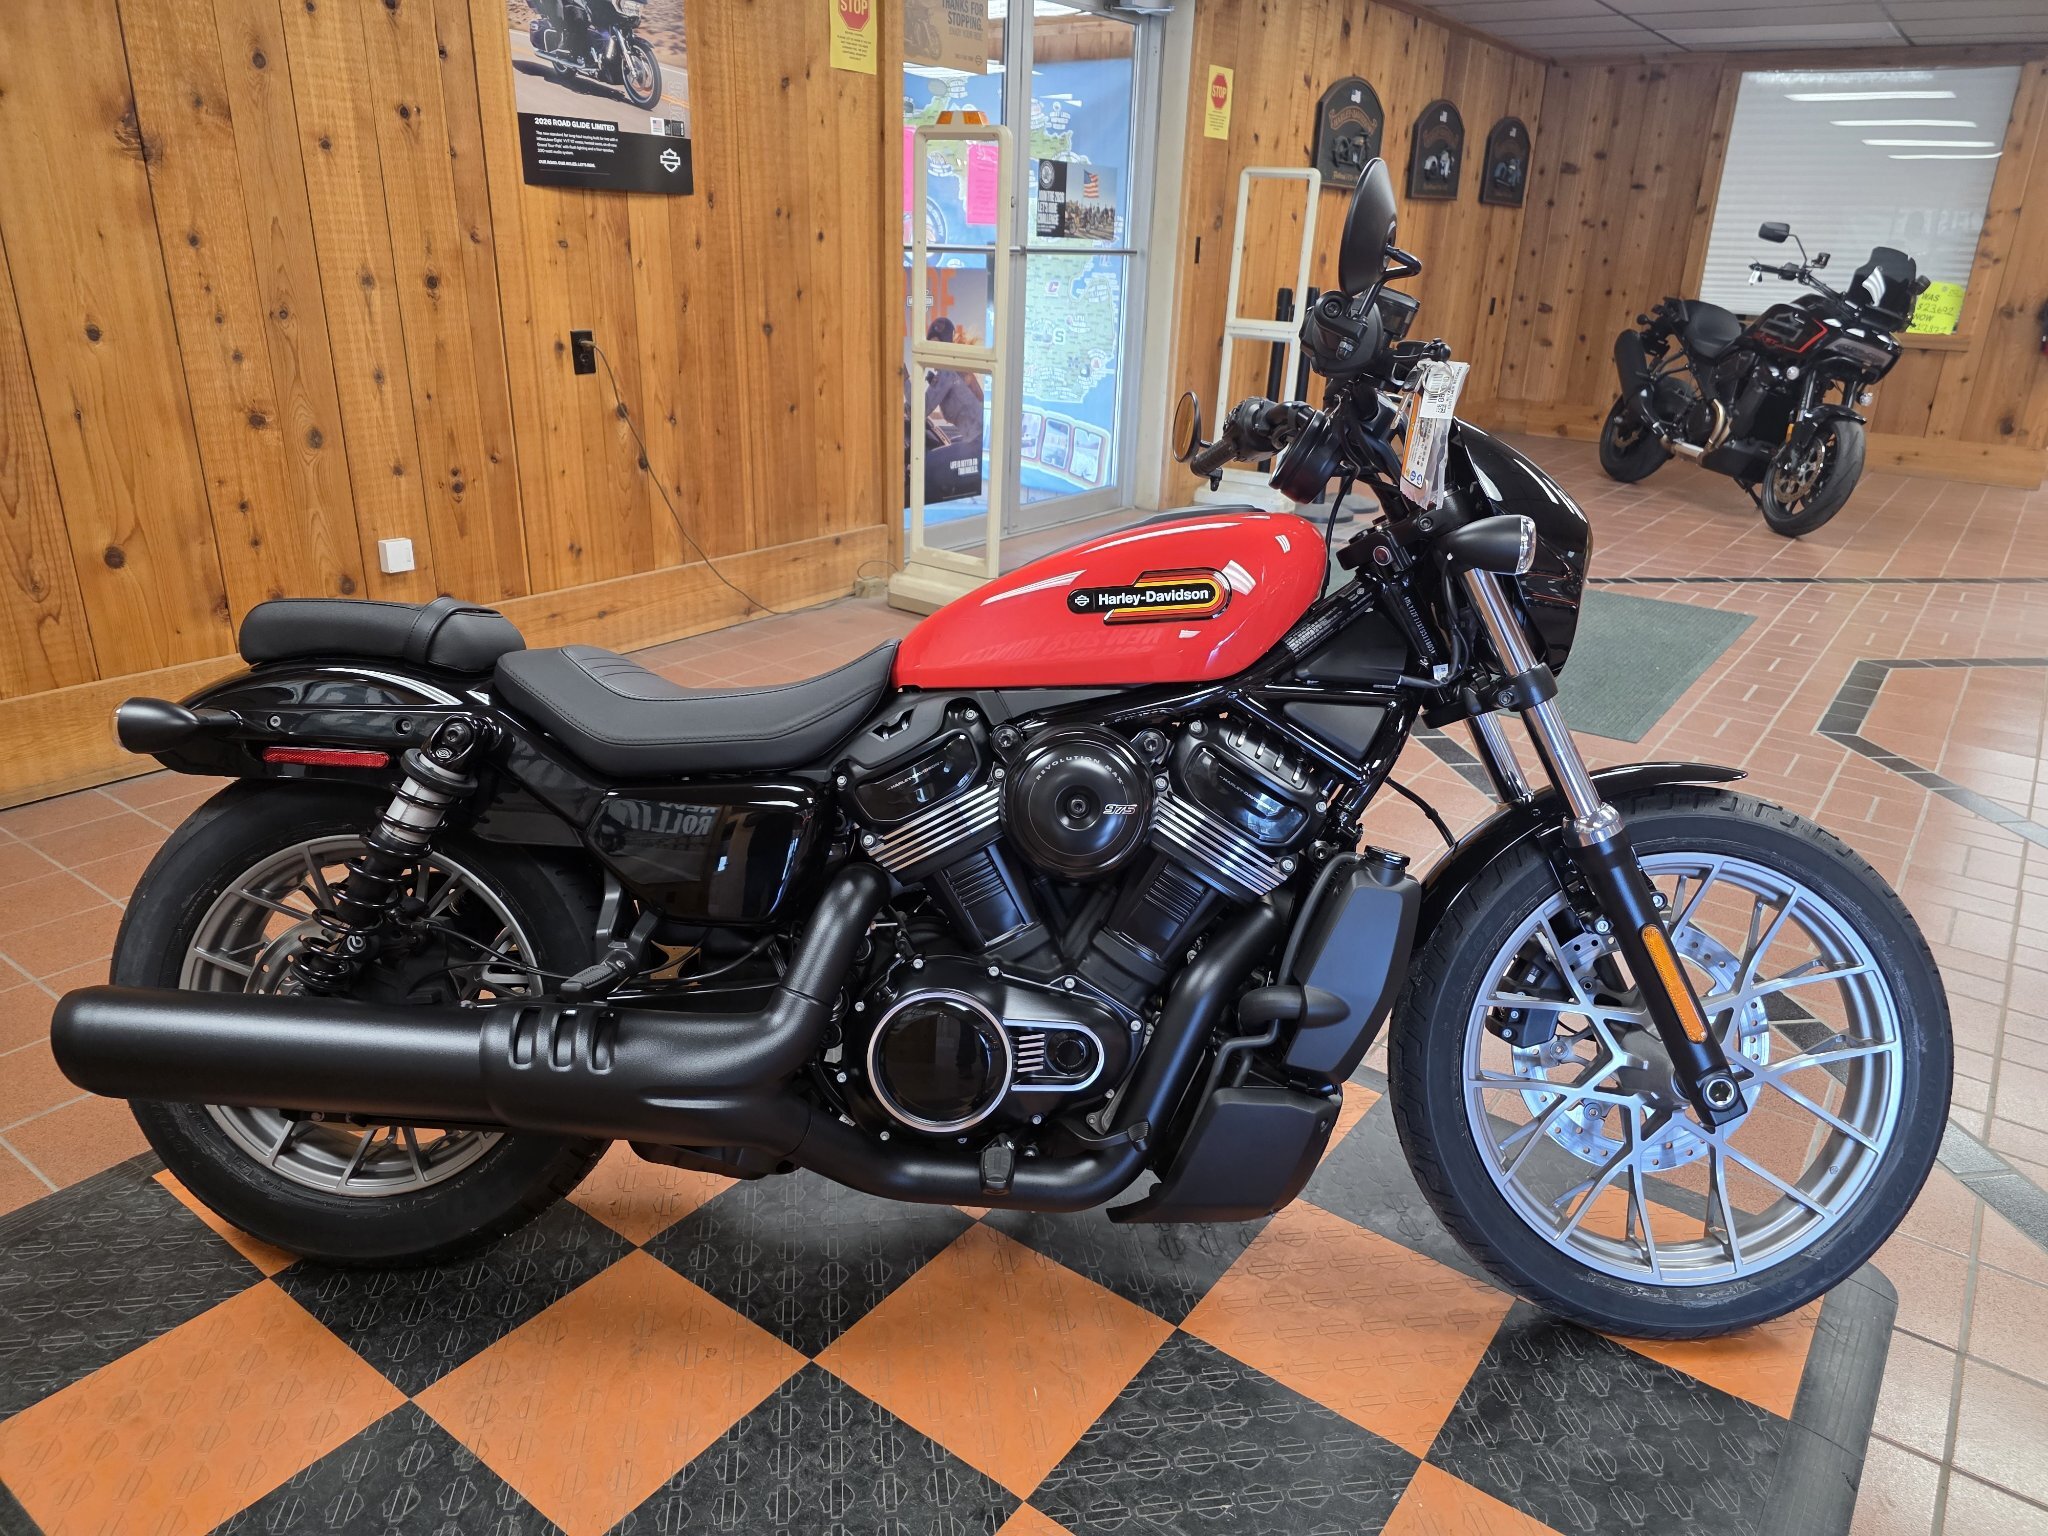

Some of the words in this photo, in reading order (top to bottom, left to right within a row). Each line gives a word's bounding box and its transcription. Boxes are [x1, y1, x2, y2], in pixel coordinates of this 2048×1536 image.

[840, 0, 868, 15] STOP
[970, 2, 984, 17] FOR
[947, 11, 984, 32] STOPPING.
[1211, 84, 1227, 99] STOP
[534, 117, 552, 126] 2026
[552, 119, 571, 128] ROAD
[571, 121, 590, 130] GLIDE
[590, 122, 616, 132] LIMITED
[1098, 588, 1210, 607] Harley-Davidson
[1035, 755, 1100, 781] REVOLUTION
[1104, 764, 1124, 784] MAX
[1102, 803, 1138, 815] 975
